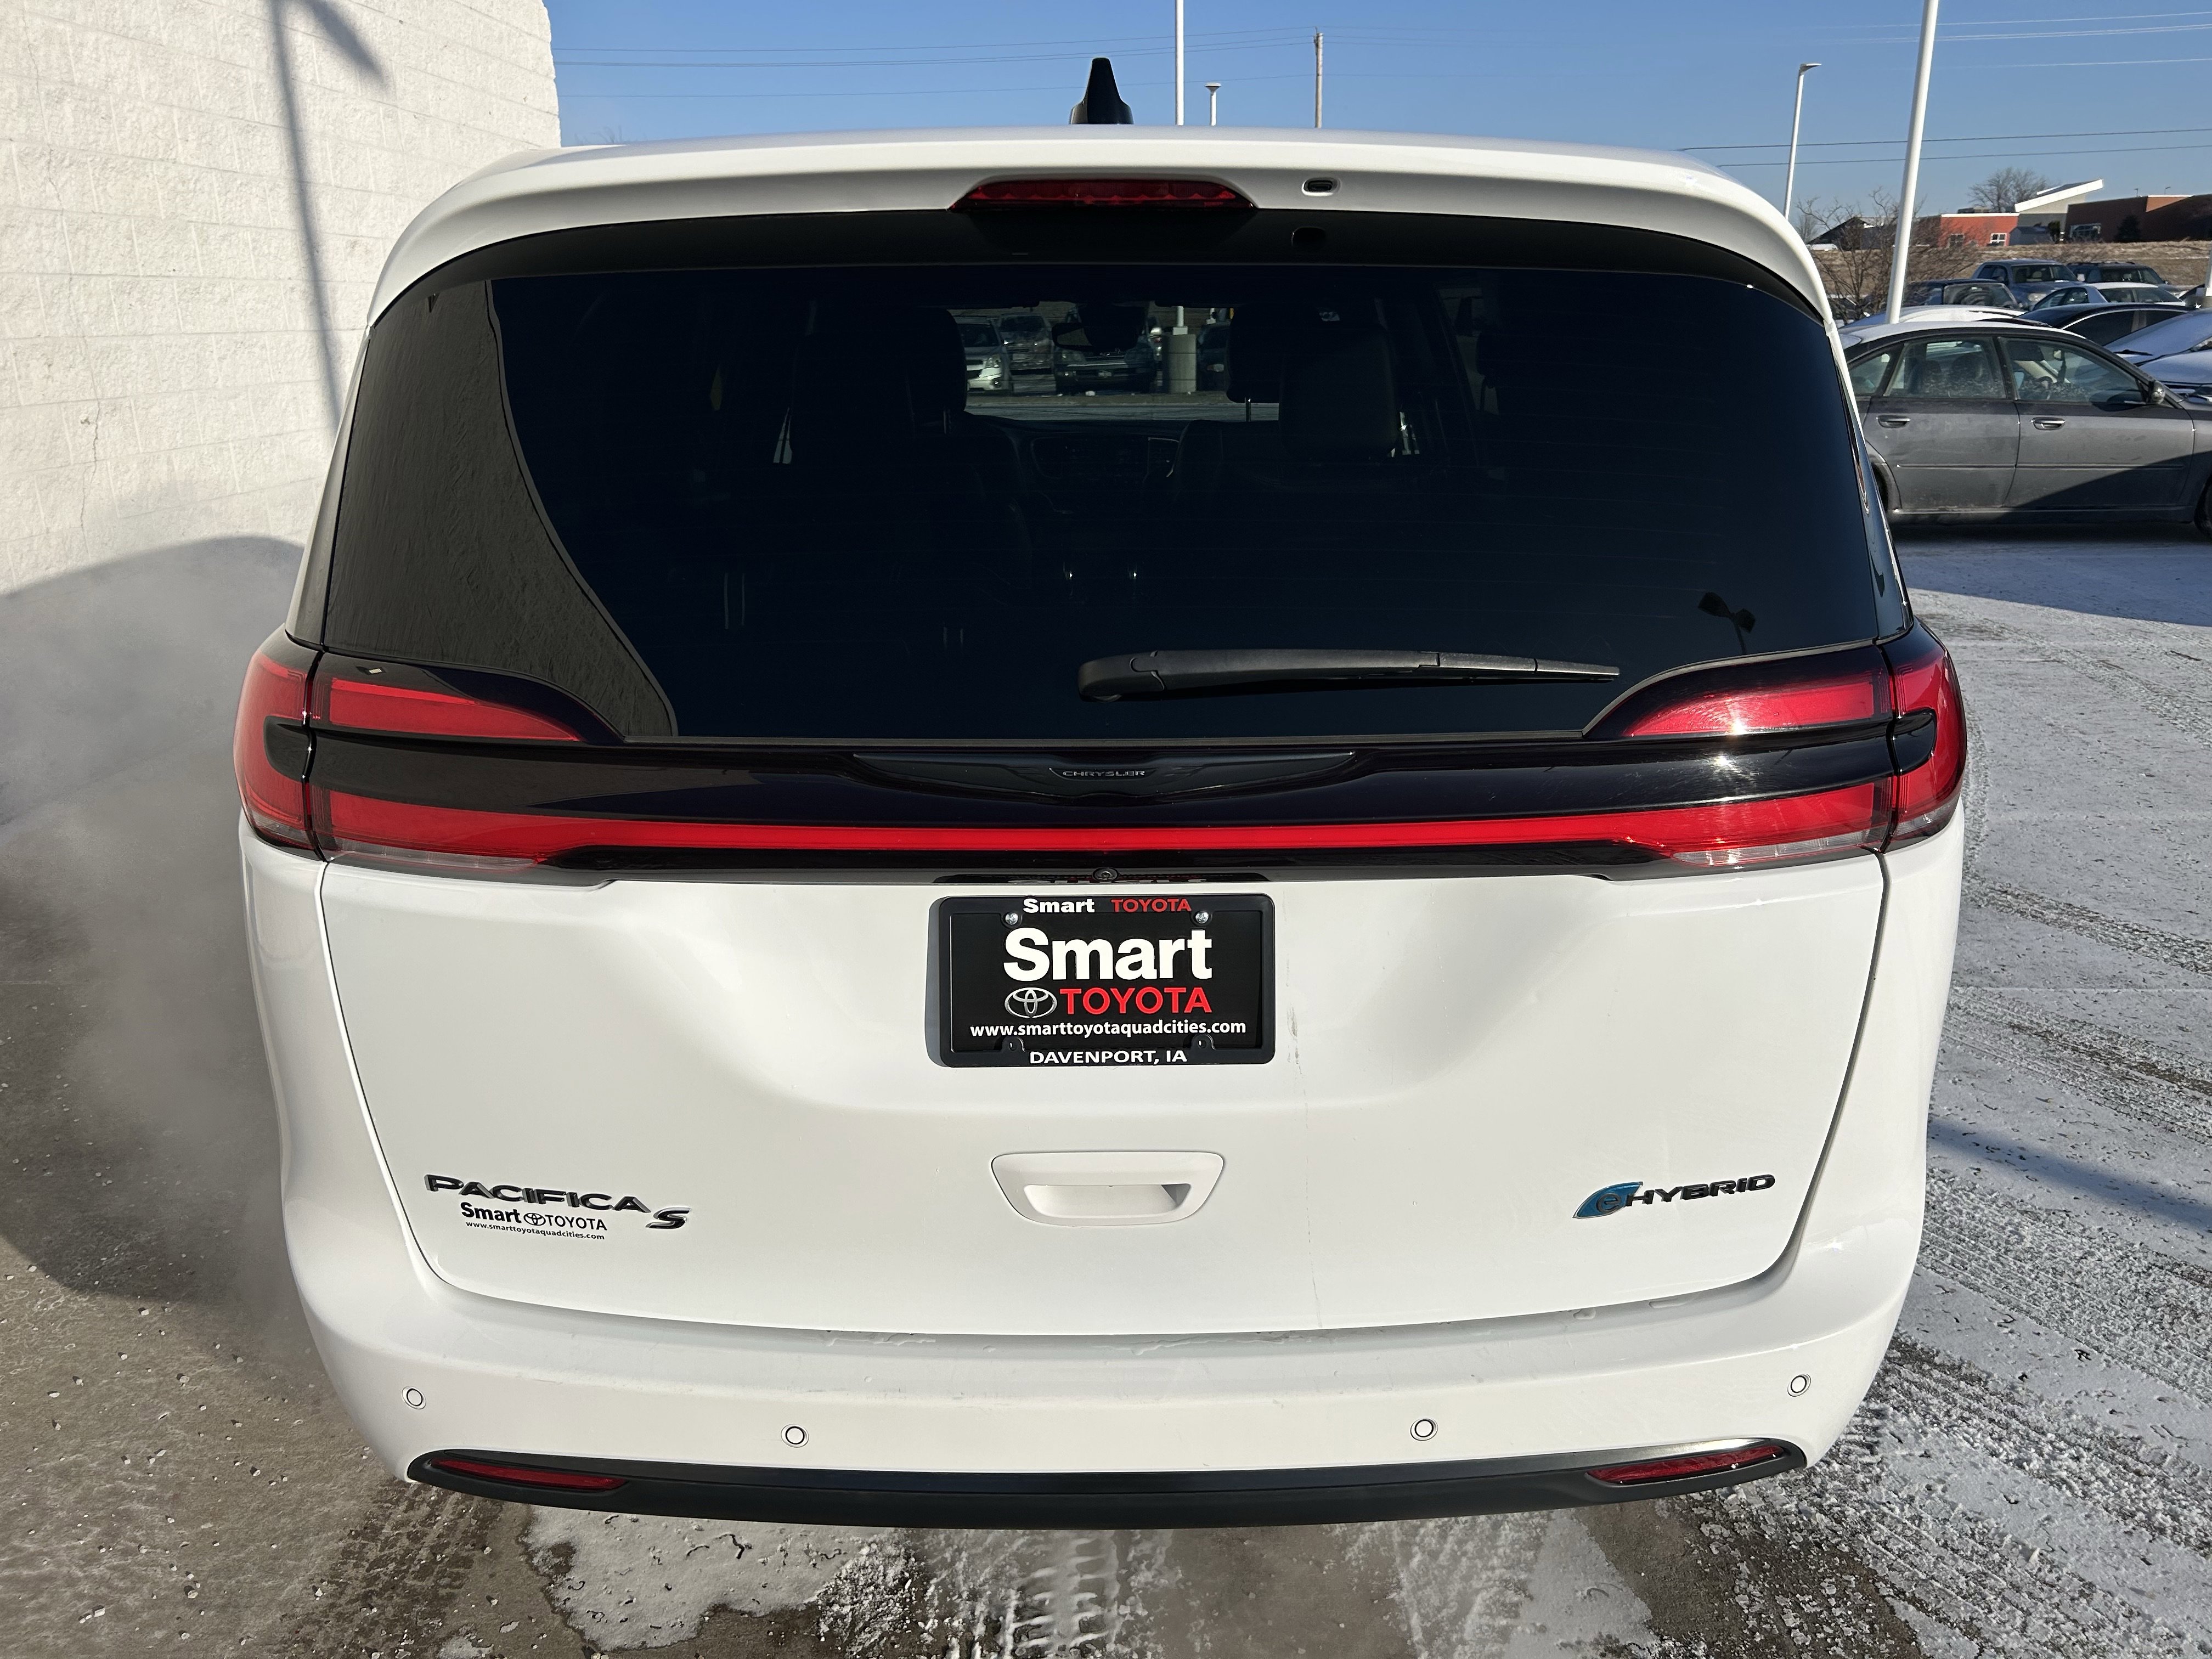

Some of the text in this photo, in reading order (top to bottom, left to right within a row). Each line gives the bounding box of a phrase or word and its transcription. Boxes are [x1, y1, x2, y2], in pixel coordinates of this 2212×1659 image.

[1023, 898, 1192, 913] Smart TOYOTA
[1003, 927, 1212, 981] Smart
[1060, 988, 1212, 1014] TOYOTA
[970, 1019, 1246, 1037] www.smarttoyotaquadcities.com
[1029, 1050, 1188, 1065] DAVENPORT, IA
[424, 1174, 691, 1229] PACIFICA S
[460, 1201, 608, 1231] Smart TOYOTA
[465, 1220, 605, 1240] www.smarttoyotaquadcities.com
